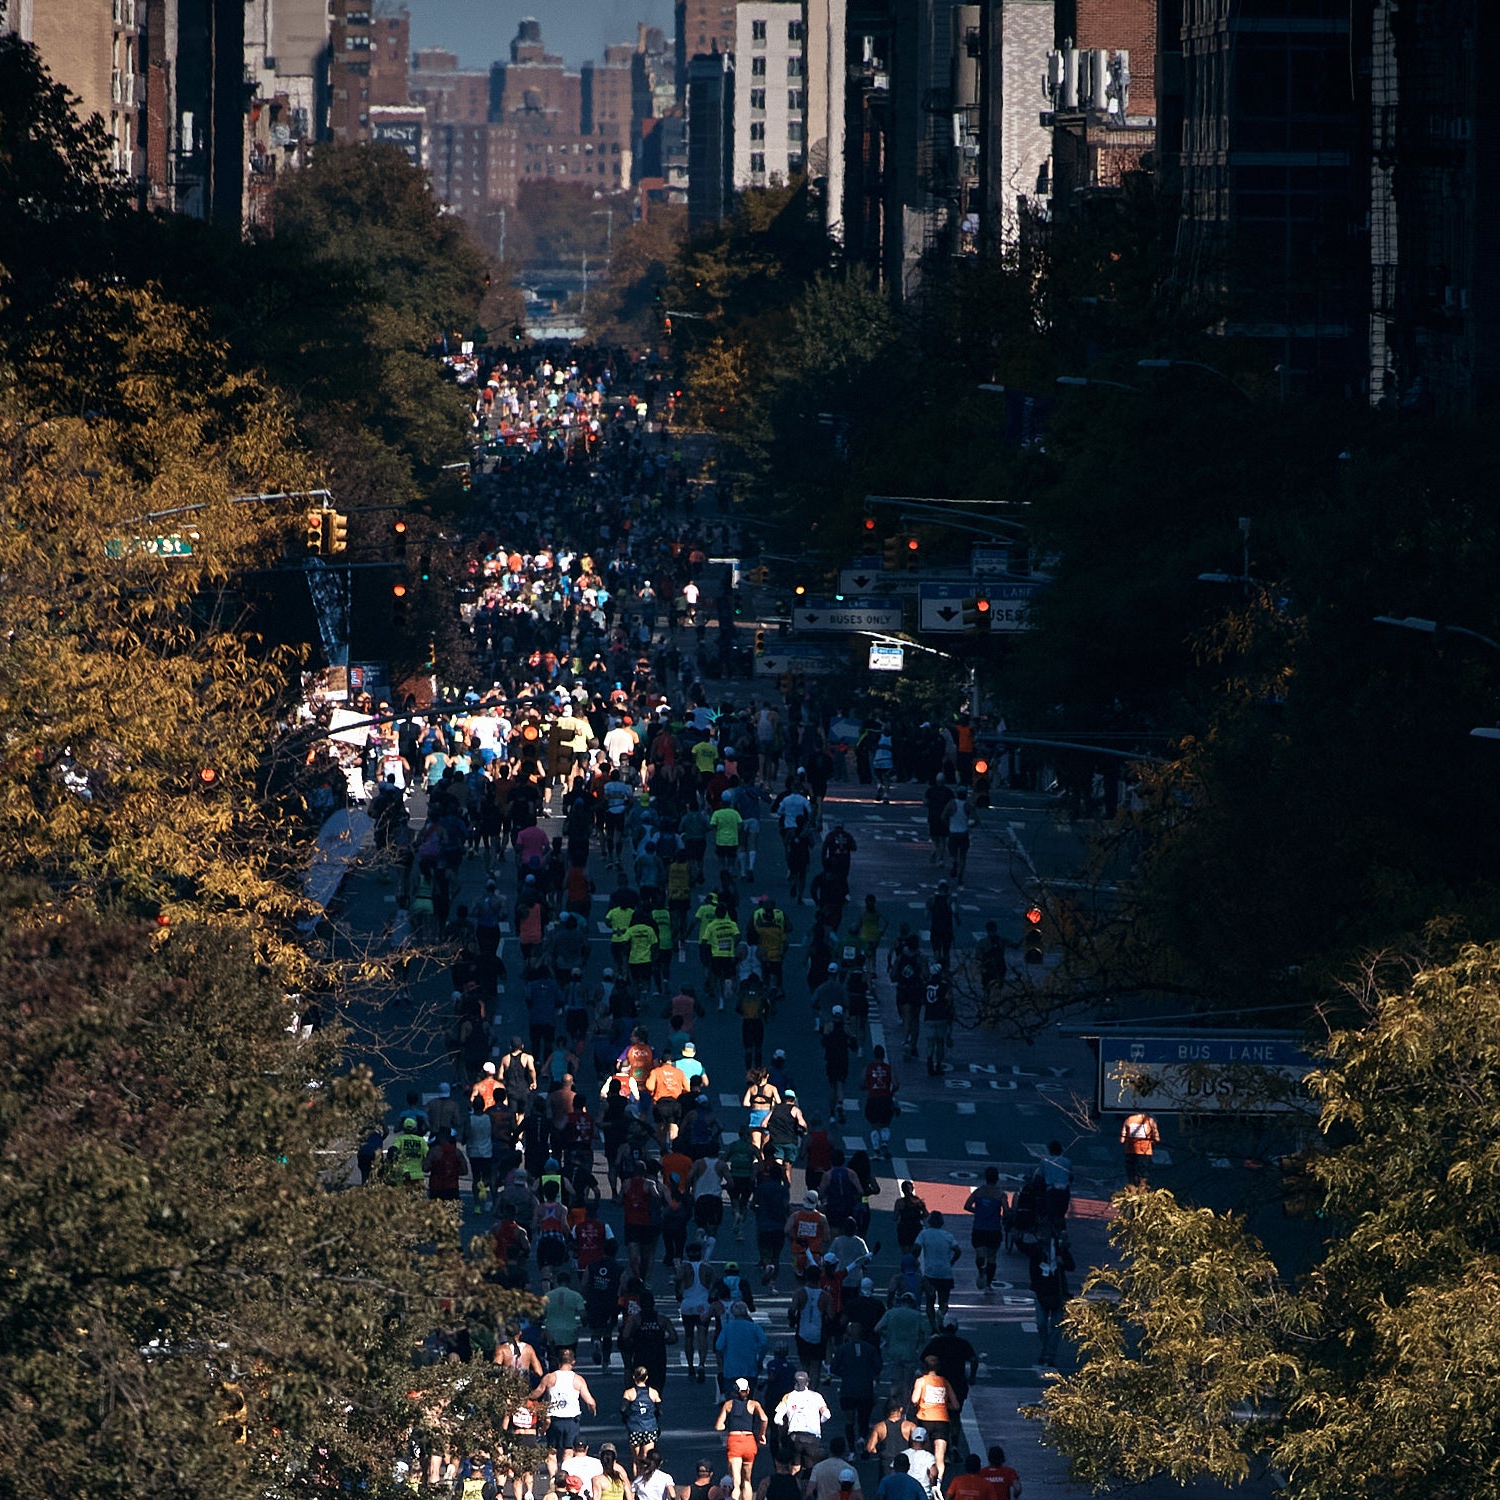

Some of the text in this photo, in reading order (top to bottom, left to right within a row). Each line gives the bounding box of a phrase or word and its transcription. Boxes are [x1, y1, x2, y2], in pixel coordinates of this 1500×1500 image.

[989, 610, 1020, 622] USES
[1178, 1045, 1274, 1062] BUS LANE
[944, 1079, 1064, 1092] BUS
